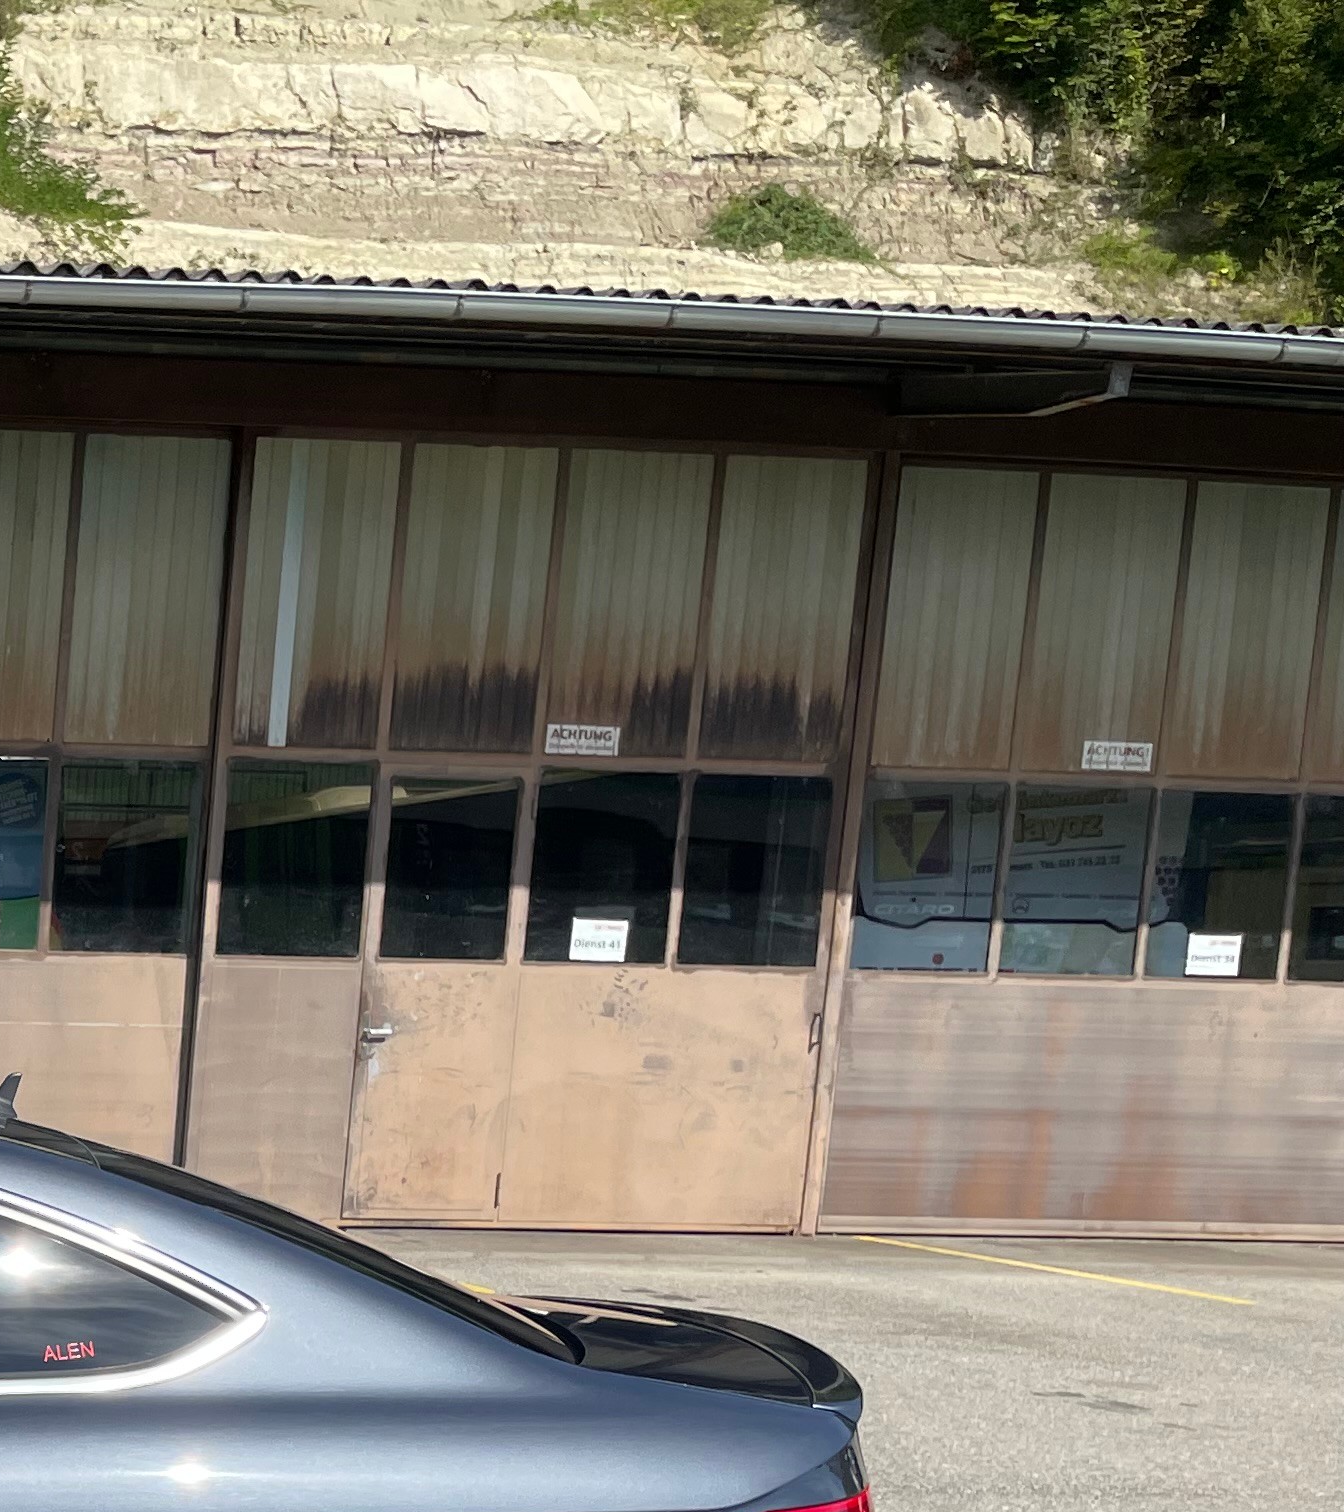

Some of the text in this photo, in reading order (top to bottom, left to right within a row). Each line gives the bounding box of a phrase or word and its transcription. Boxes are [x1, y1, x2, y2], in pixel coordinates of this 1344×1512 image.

[574, 938, 621, 949] Dienst 41
[43, 1340, 95, 1363] ALEN
